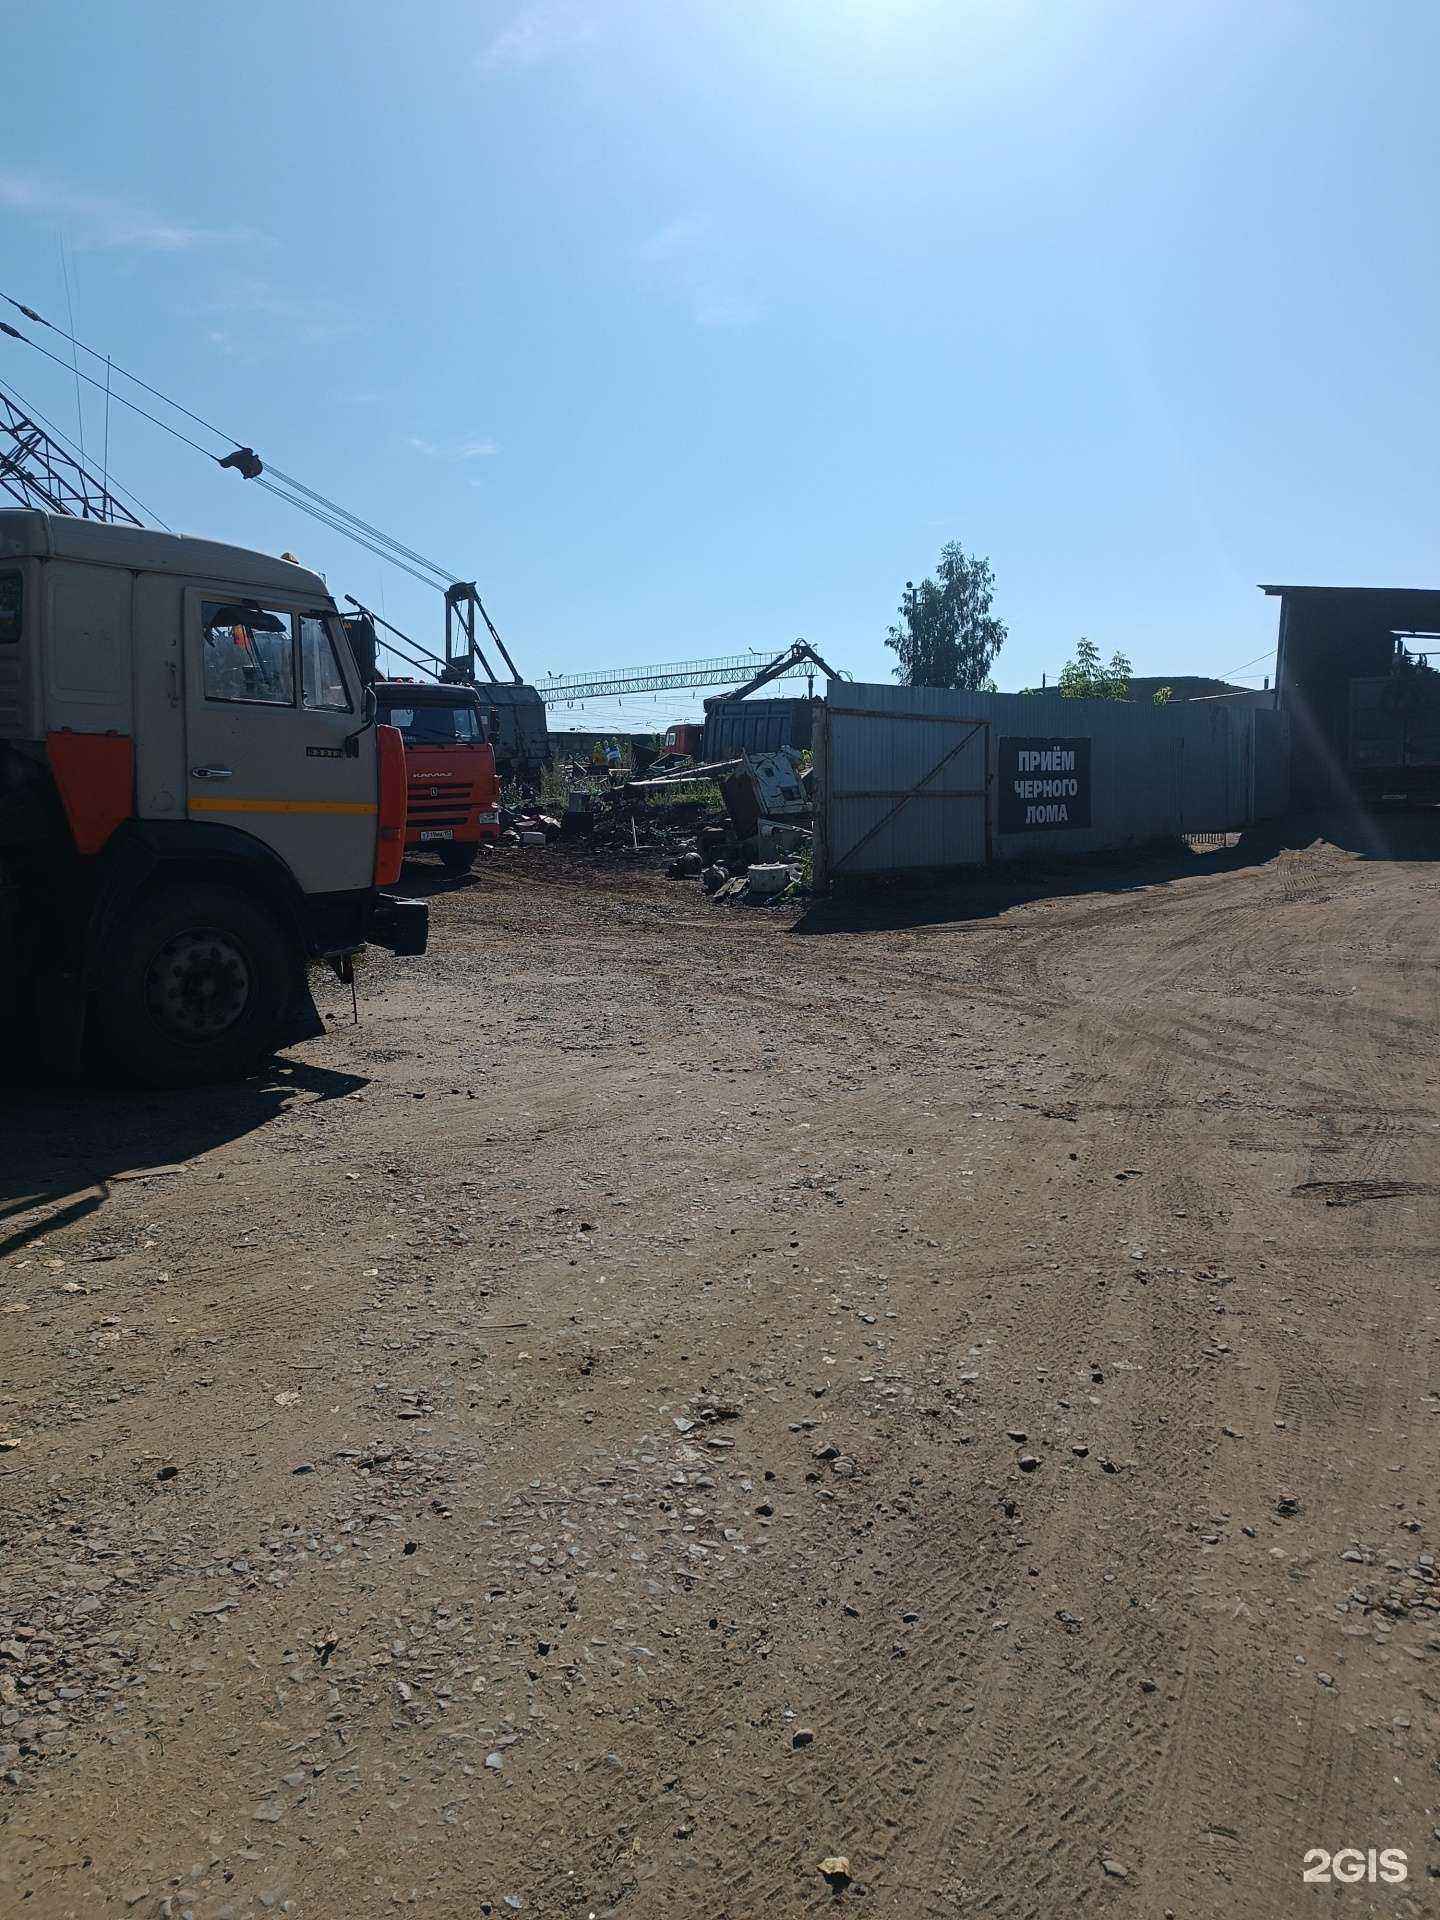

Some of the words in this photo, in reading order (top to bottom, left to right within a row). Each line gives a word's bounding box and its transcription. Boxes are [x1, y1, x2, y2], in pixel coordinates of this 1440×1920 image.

[1018, 746, 1075, 771] ПРИЁМ
[1014, 779, 1078, 799] ЧЕРНОГО
[1024, 804, 1068, 824] ЛОМА
